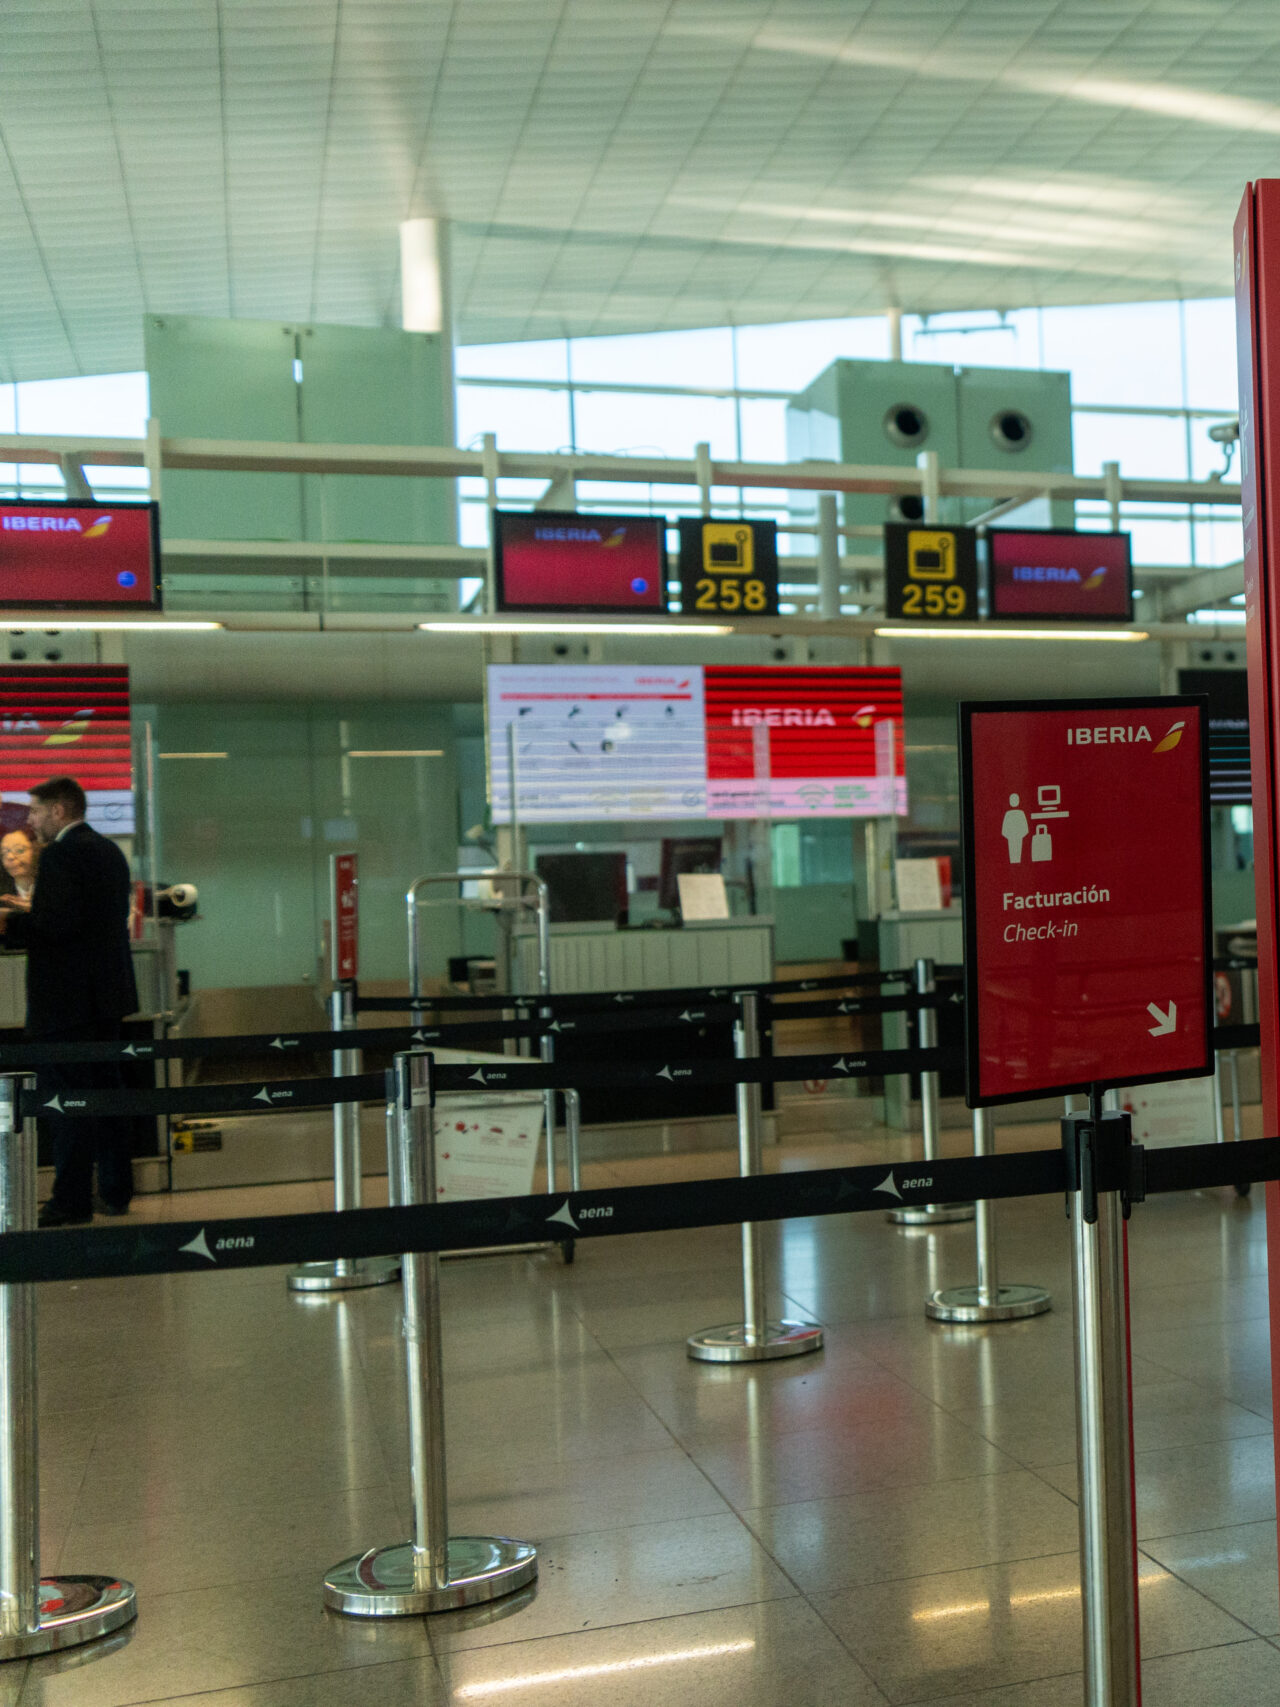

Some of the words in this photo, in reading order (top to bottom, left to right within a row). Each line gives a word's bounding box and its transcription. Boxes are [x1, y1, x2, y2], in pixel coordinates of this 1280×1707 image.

[1, 516, 82, 532] IBERIA
[534, 526, 603, 542] IBERIA
[1012, 566, 1082, 583] IBERIA
[695, 579, 767, 612] 258
[902, 584, 967, 616] 259
[731, 708, 837, 727] IBERIA
[1066, 725, 1153, 746] IBERIA
[1002, 884, 1111, 911] Facturación
[1003, 921, 1079, 943] Check-in
[487, 1072, 507, 1080] aena
[272, 1090, 293, 1098] aena
[64, 1099, 86, 1108] aena
[901, 1176, 934, 1189] aena
[578, 1204, 614, 1220] aena
[215, 1234, 255, 1251] aena
